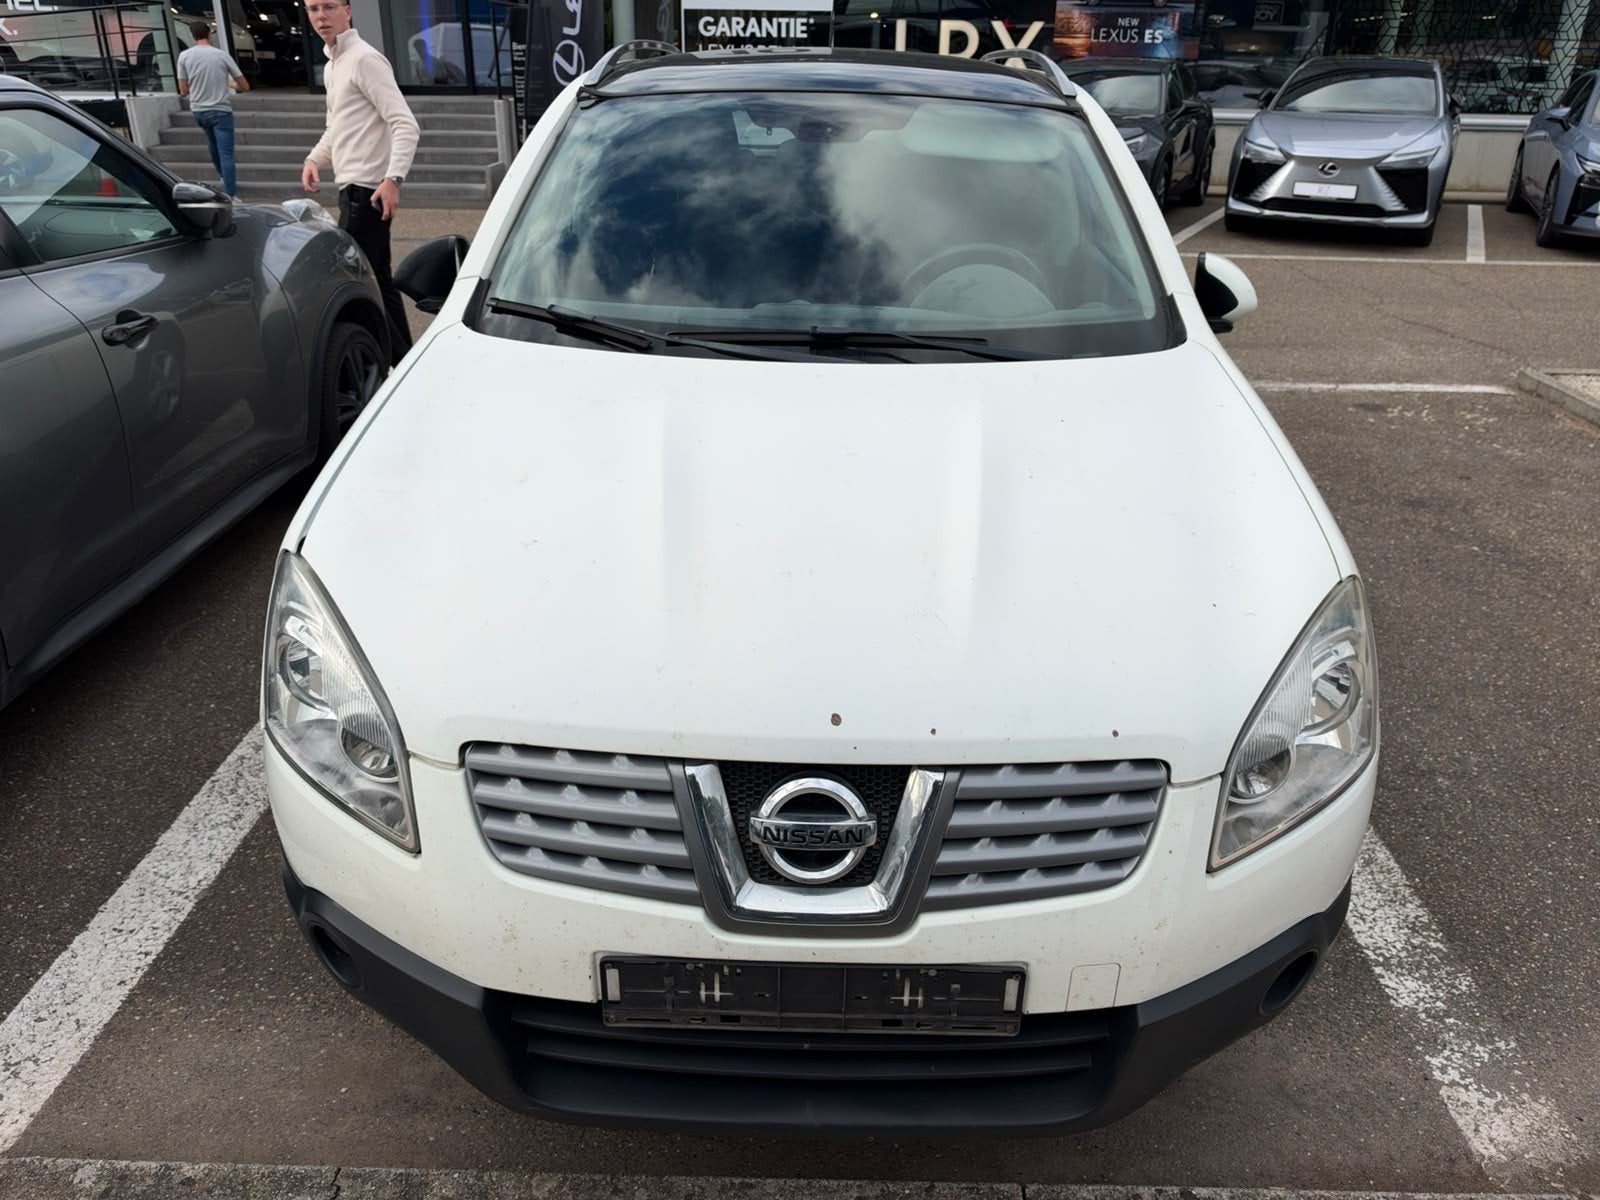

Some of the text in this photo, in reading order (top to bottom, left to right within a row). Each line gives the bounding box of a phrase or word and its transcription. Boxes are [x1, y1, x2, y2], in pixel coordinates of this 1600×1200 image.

[1117, 17, 1140, 27] NEW
[1090, 28, 1164, 44] LEXUS ES
[762, 825, 863, 845] NISSAN
